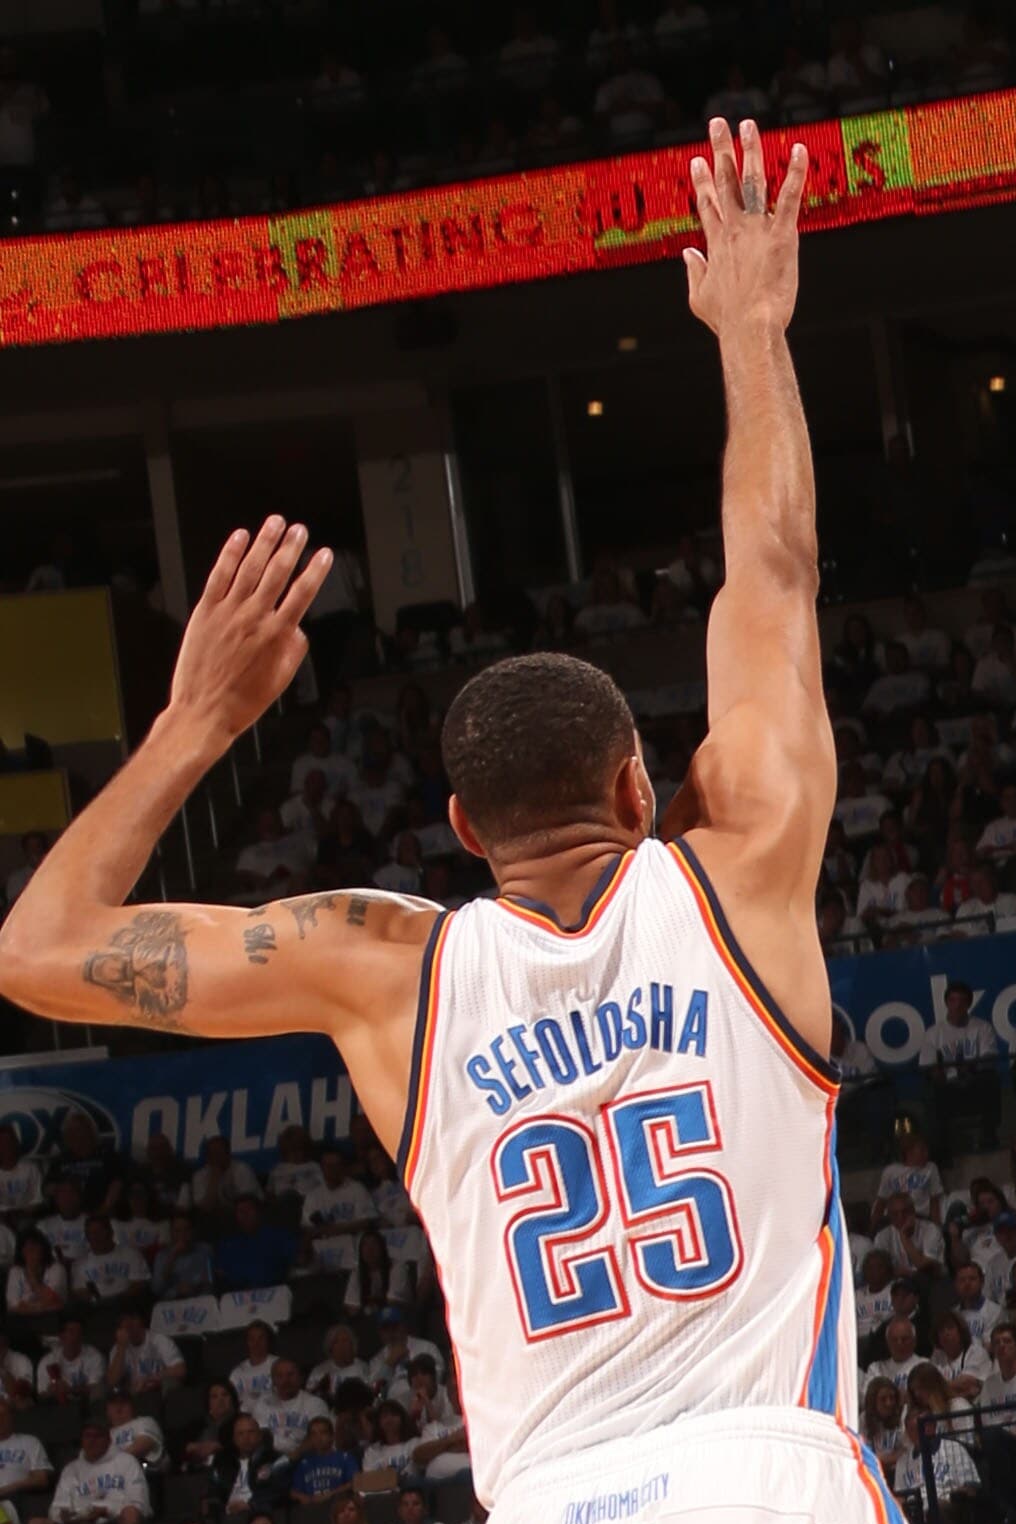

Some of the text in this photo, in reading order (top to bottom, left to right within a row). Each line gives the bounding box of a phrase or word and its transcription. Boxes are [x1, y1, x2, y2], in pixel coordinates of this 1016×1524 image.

[75, 203, 543, 302] CELEBRATING
[465, 981, 709, 1117] SEFOLOSHA
[131, 1074, 364, 1163] OKLAH
[489, 1080, 745, 1344] 25
